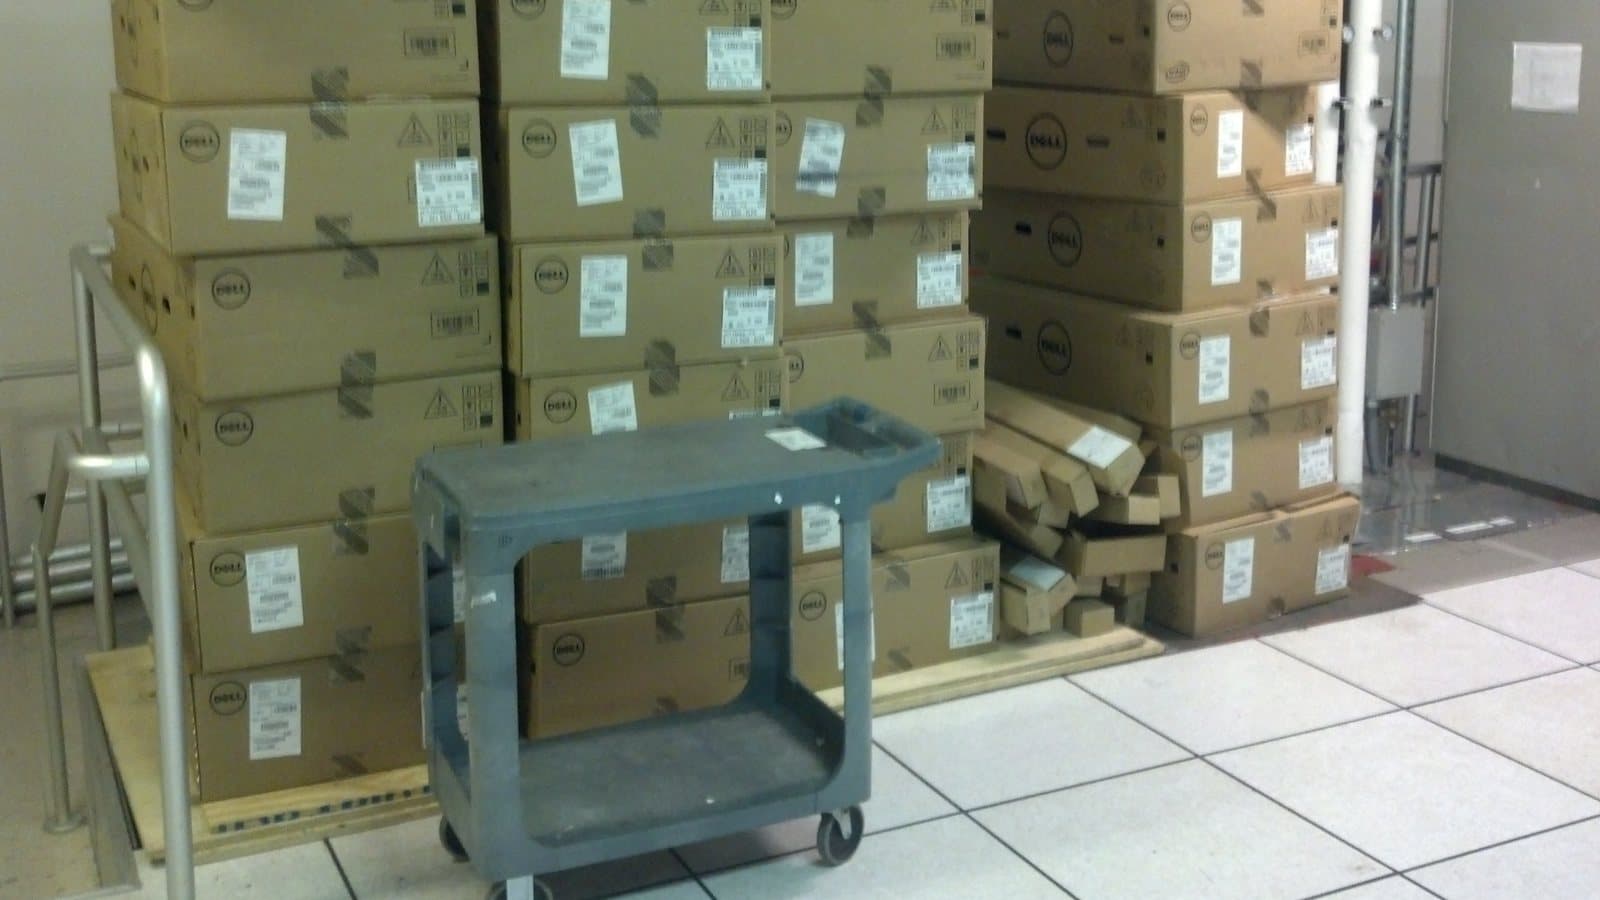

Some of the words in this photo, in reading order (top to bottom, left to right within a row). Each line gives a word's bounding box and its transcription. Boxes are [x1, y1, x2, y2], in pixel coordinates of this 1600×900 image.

[1030, 135, 1062, 150] DELL
[1051, 232, 1080, 248] DELL
[215, 284, 246, 297] DELL
[1041, 340, 1068, 358] DELL
[547, 401, 573, 411] DELL
[220, 421, 249, 432] DELL
[214, 562, 243, 574] DELL
[802, 600, 823, 610] DELL
[556, 644, 580, 655] DELL
[213, 691, 242, 704] DELL
